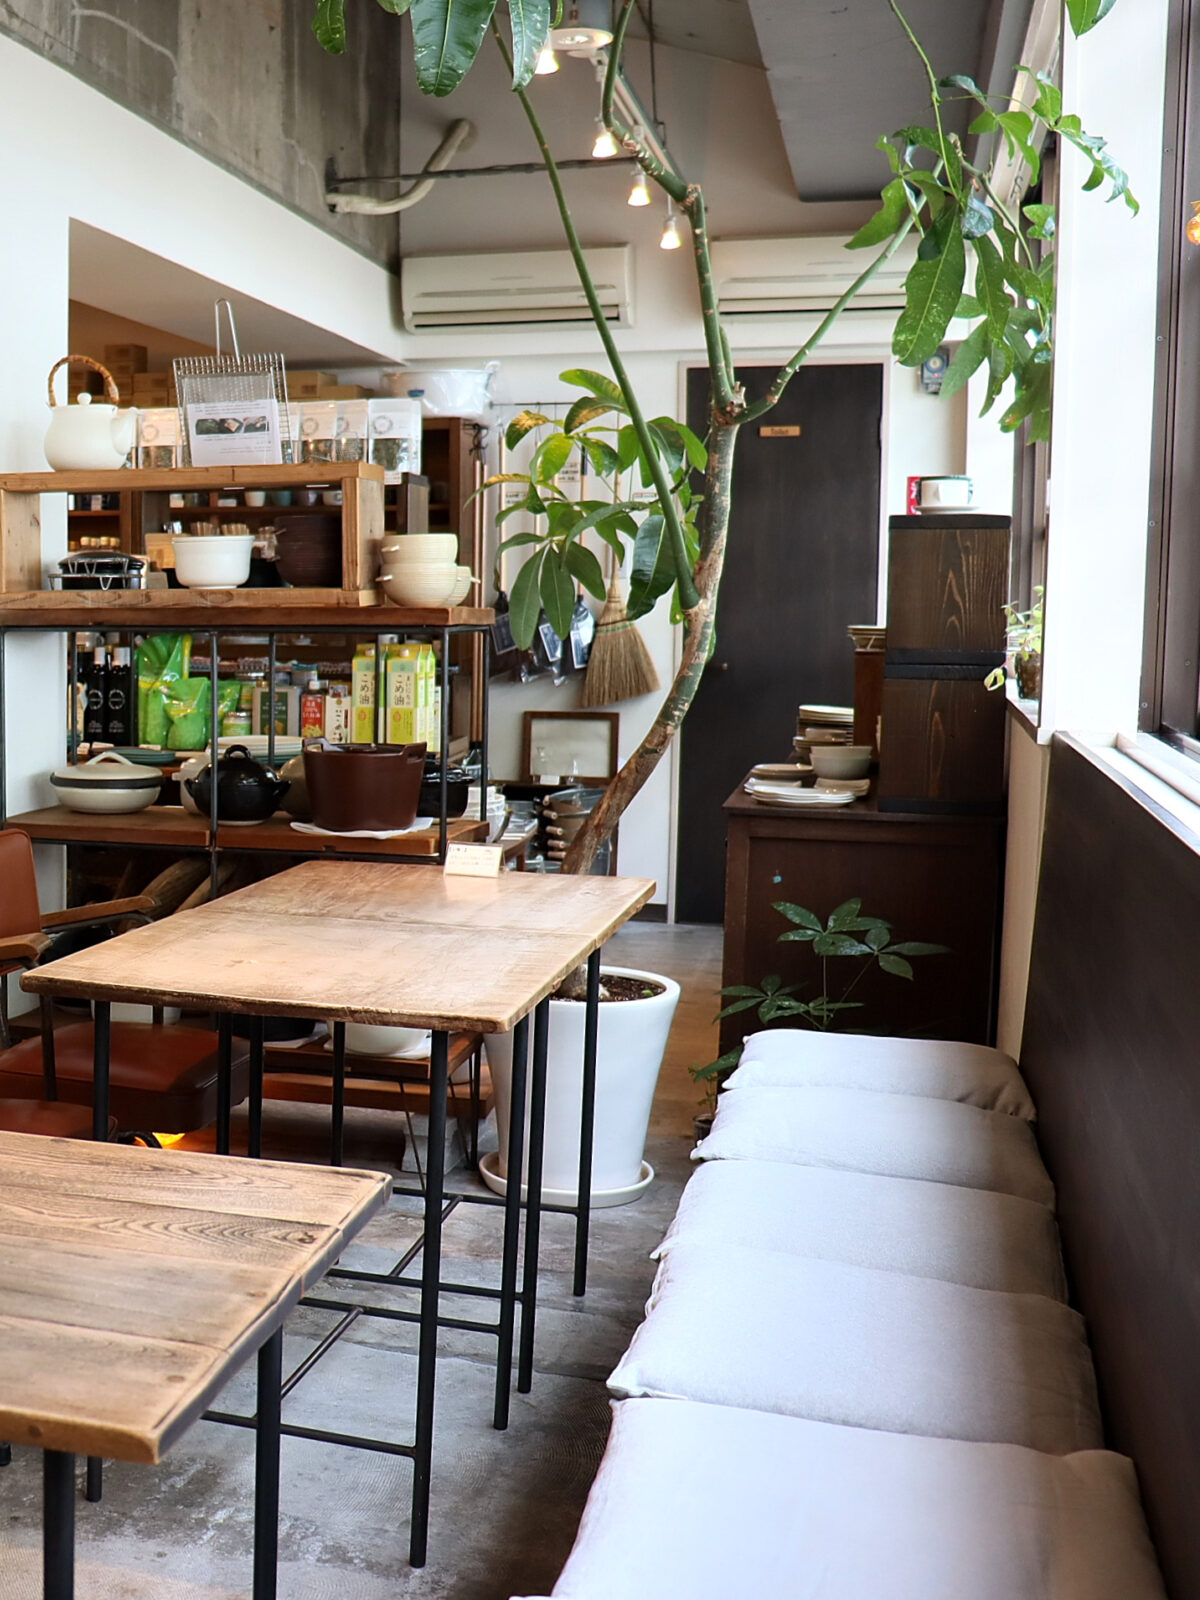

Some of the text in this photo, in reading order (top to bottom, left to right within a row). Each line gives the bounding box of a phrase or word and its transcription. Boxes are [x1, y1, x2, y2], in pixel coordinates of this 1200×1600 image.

[360, 673, 370, 705] こめ油
[394, 674, 405, 706] こめ油
